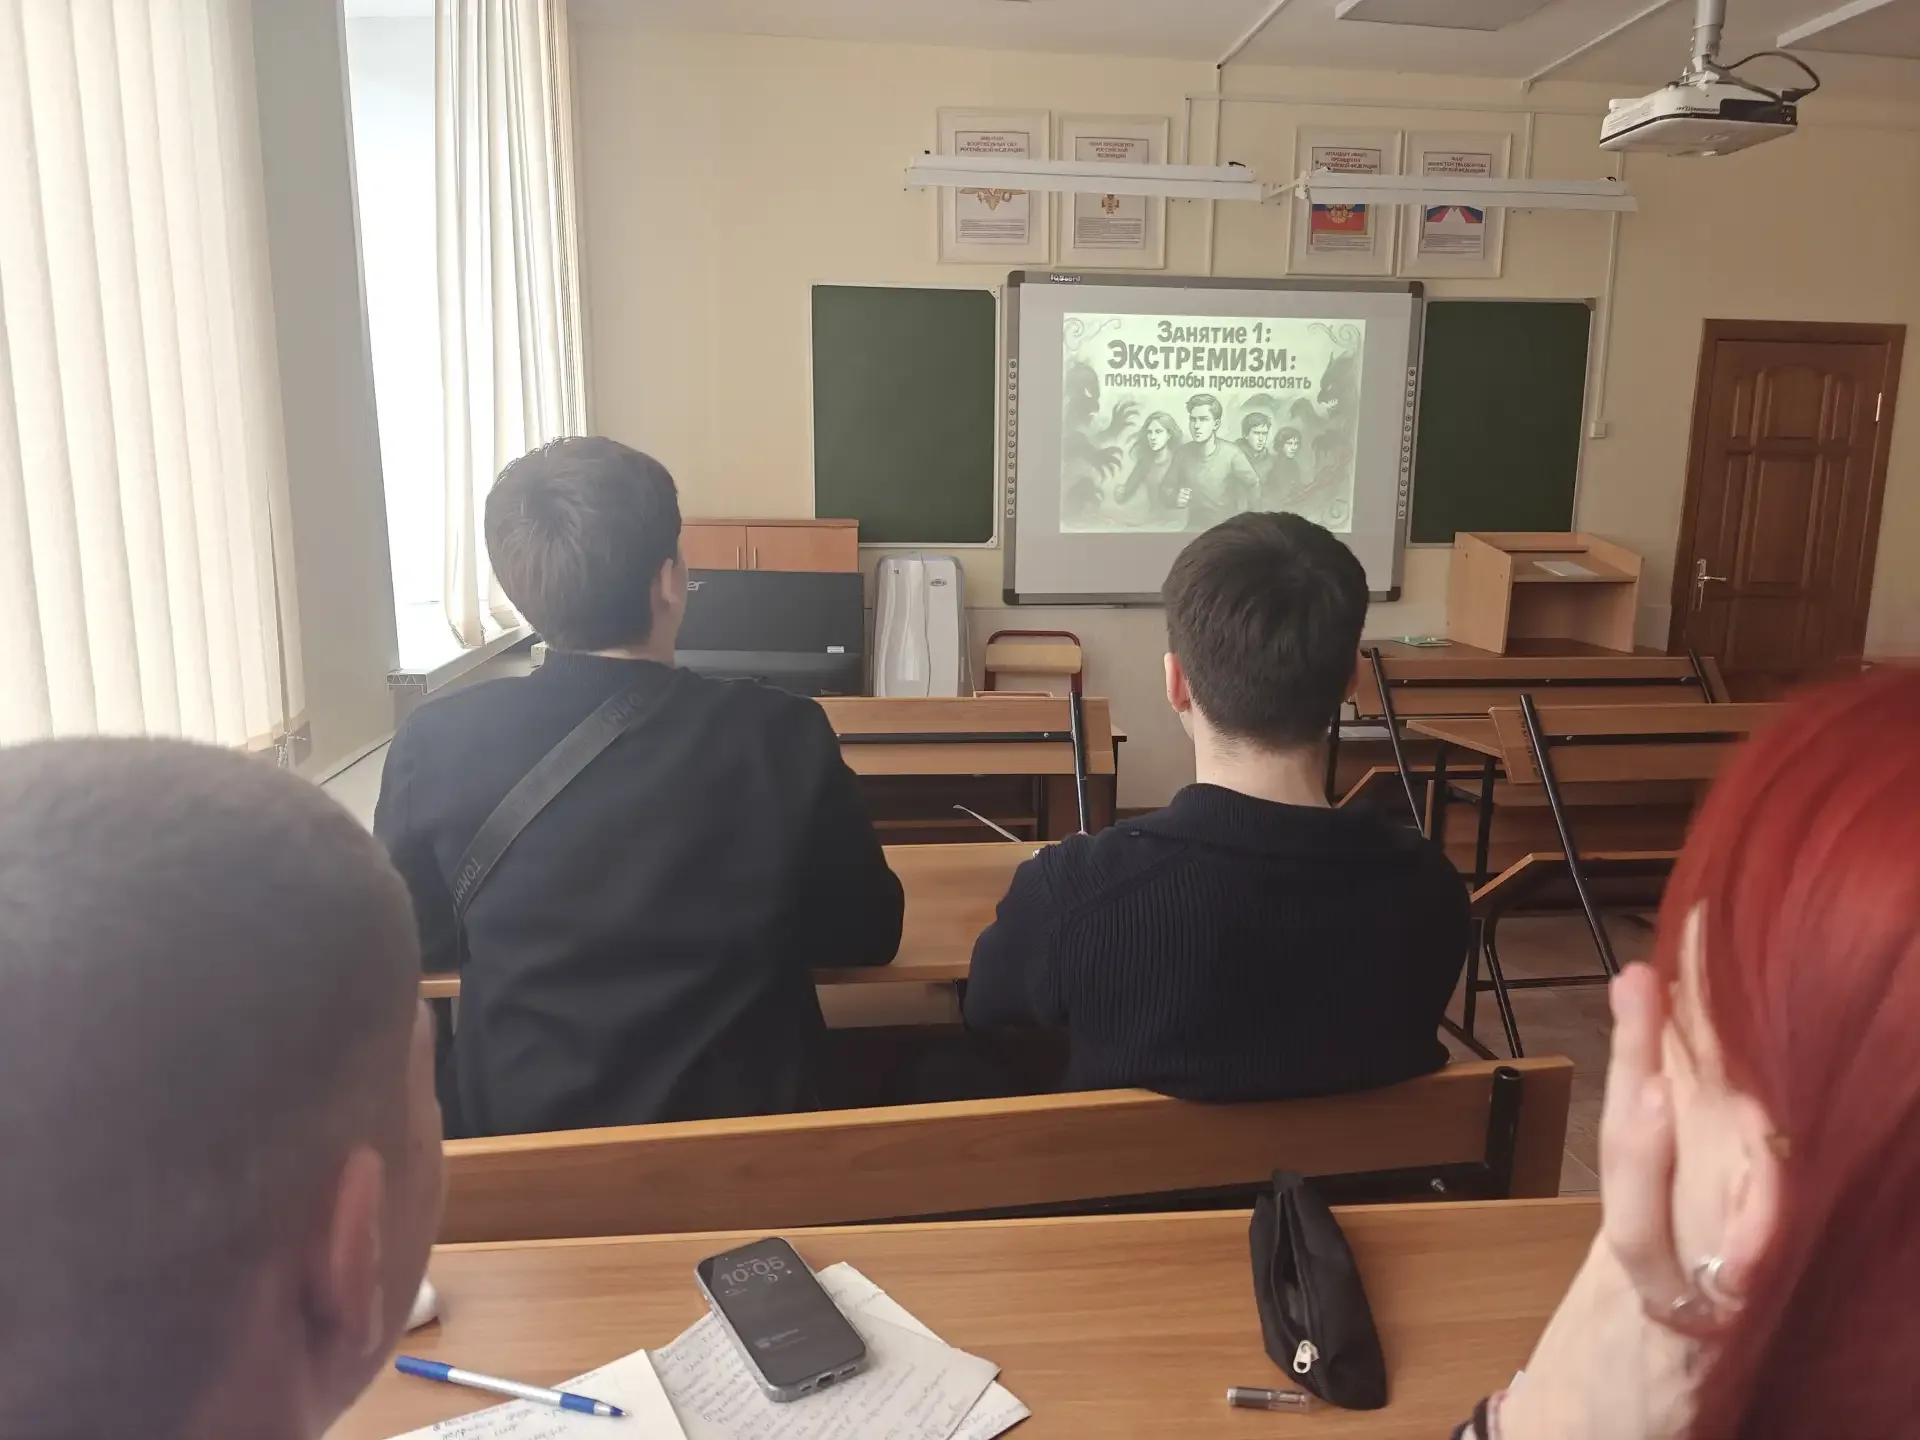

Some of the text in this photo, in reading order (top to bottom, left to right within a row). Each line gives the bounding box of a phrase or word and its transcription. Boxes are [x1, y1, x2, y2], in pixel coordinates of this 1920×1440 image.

[1157, 320, 1272, 344] Занятие 1:
[1107, 339, 1297, 372] ЭКСТРЕМИЗМ:
[1104, 371, 1312, 391] понять, чтобы противостоять
[687, 580, 709, 592] er
[720, 1256, 786, 1287] 10:05
